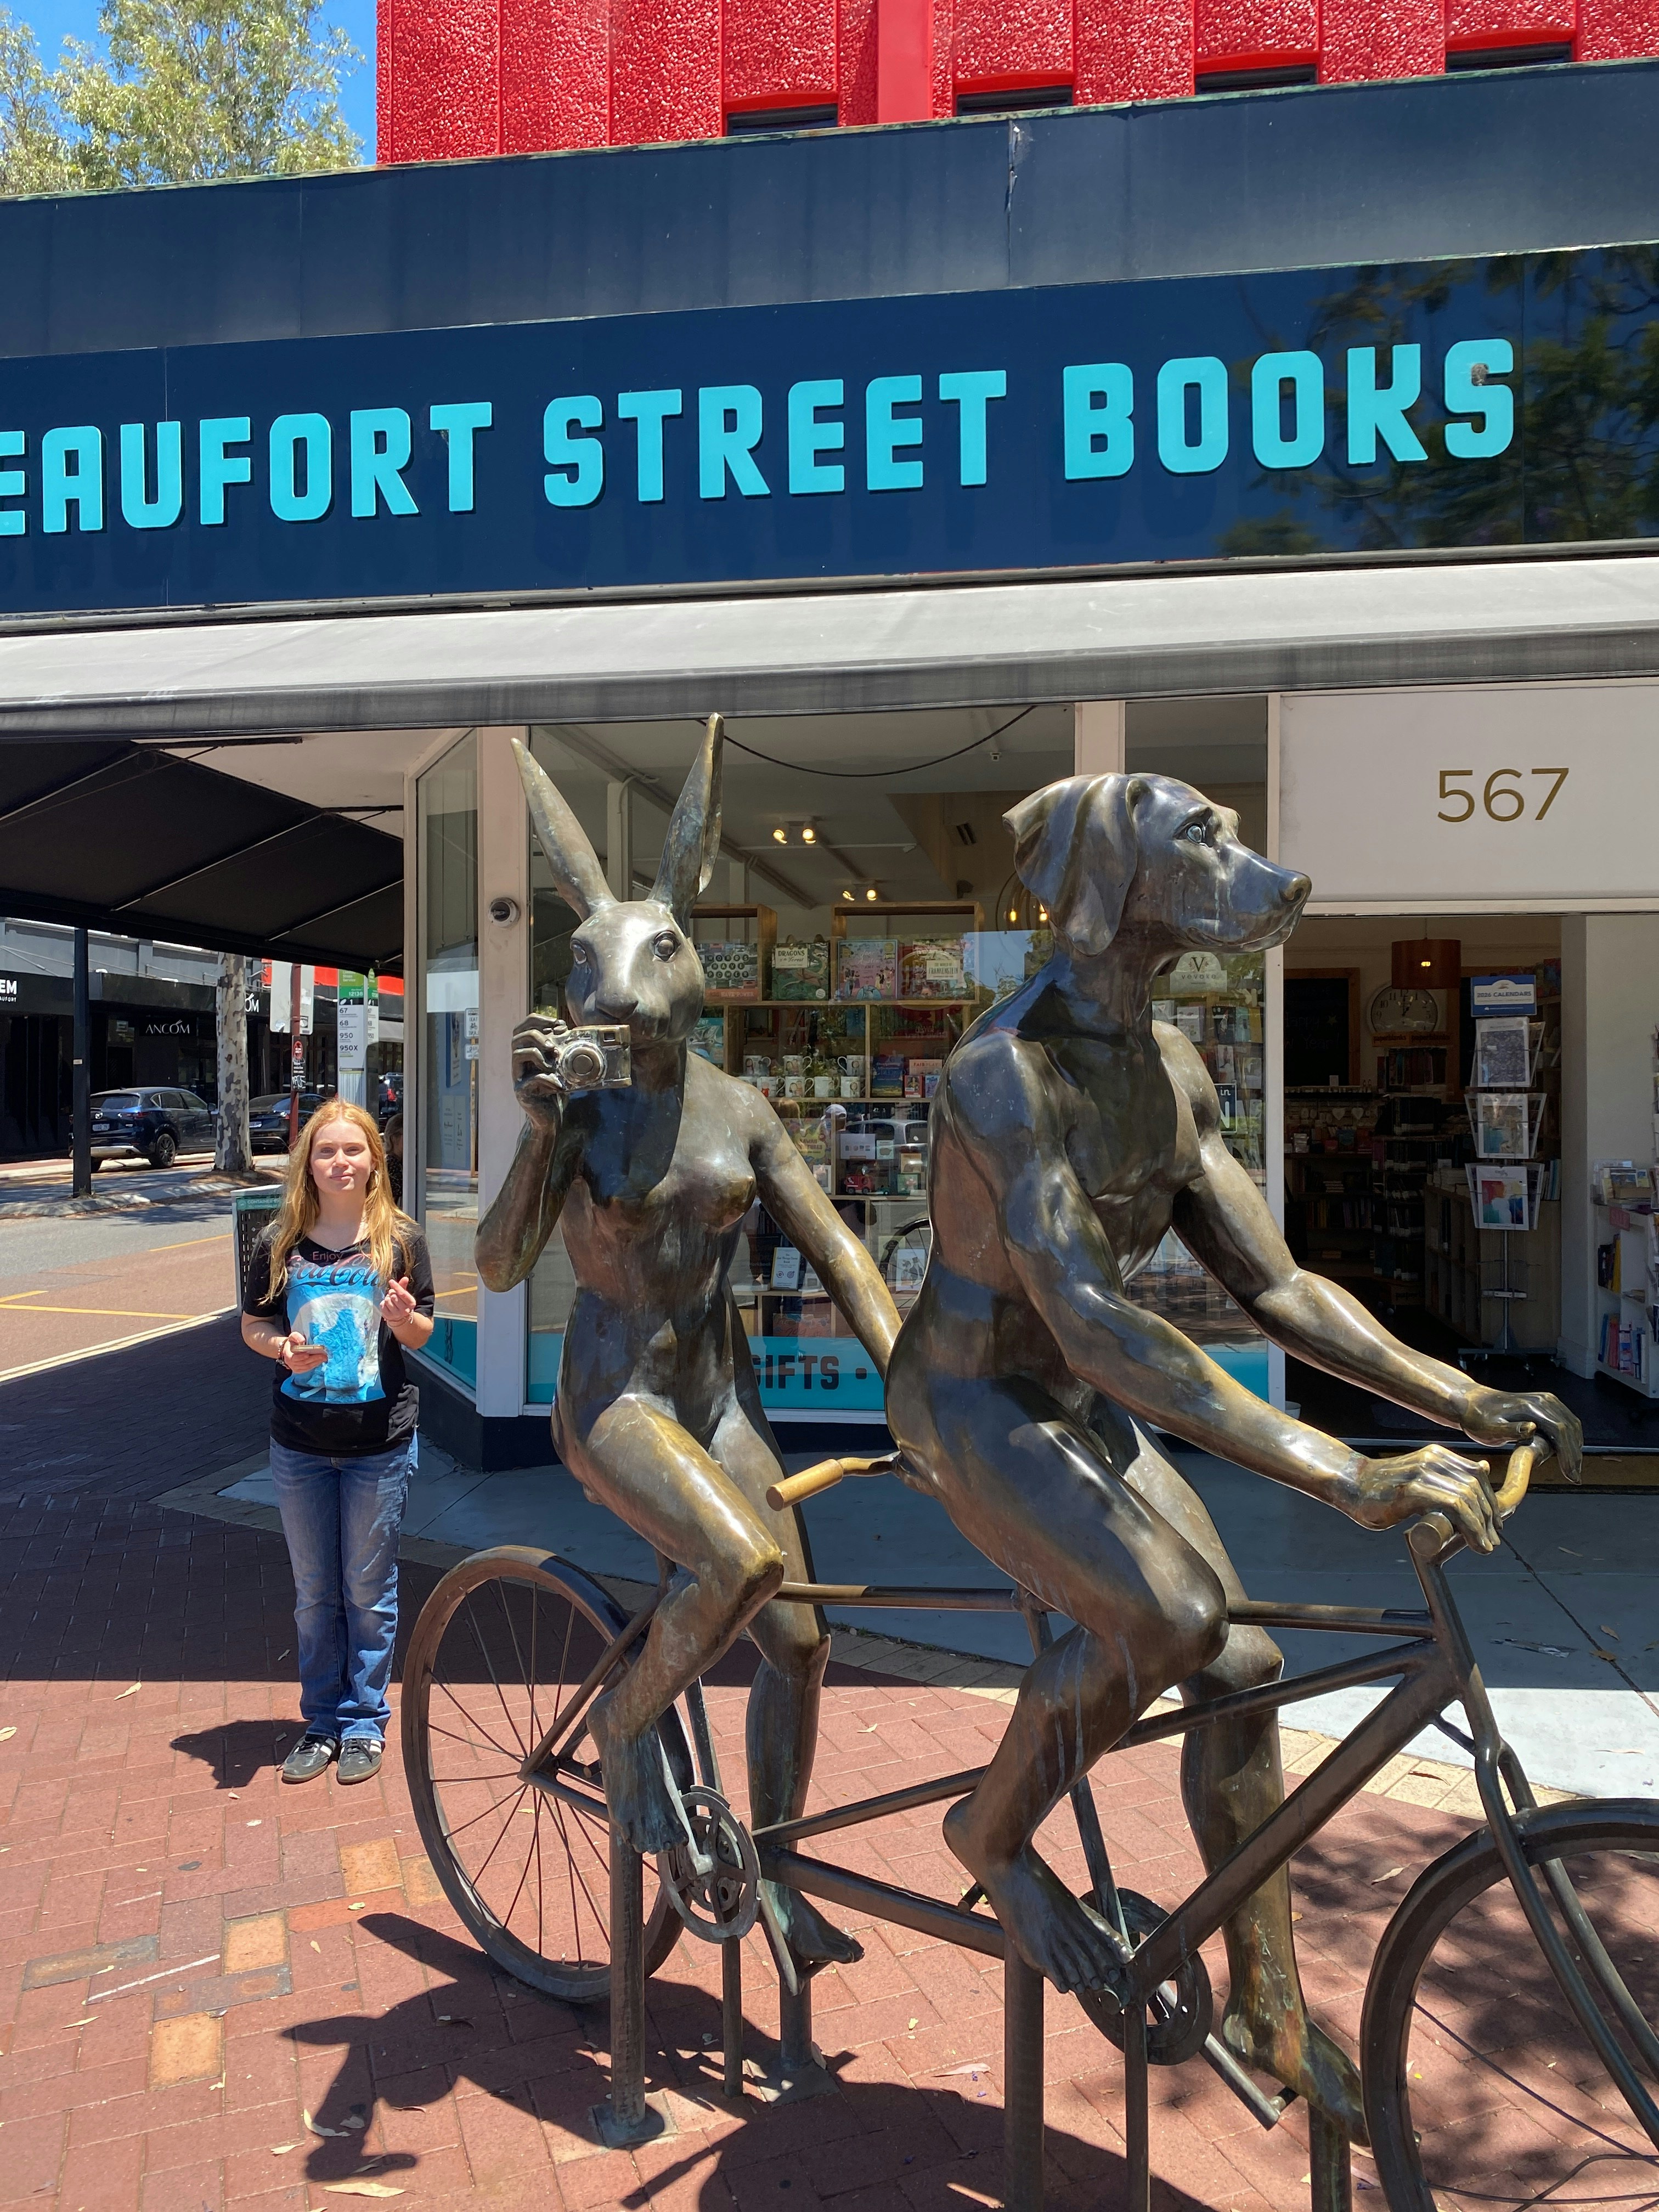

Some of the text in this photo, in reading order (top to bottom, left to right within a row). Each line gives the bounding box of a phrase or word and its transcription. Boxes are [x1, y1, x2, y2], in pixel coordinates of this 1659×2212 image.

[543, 370, 1007, 507] STREET
[1063, 338, 1514, 482] BOOKS
[1437, 768, 1569, 822] 567
[146, 1020, 190, 1034] ANCOM
[312, 1251, 343, 1262] Enjoy
